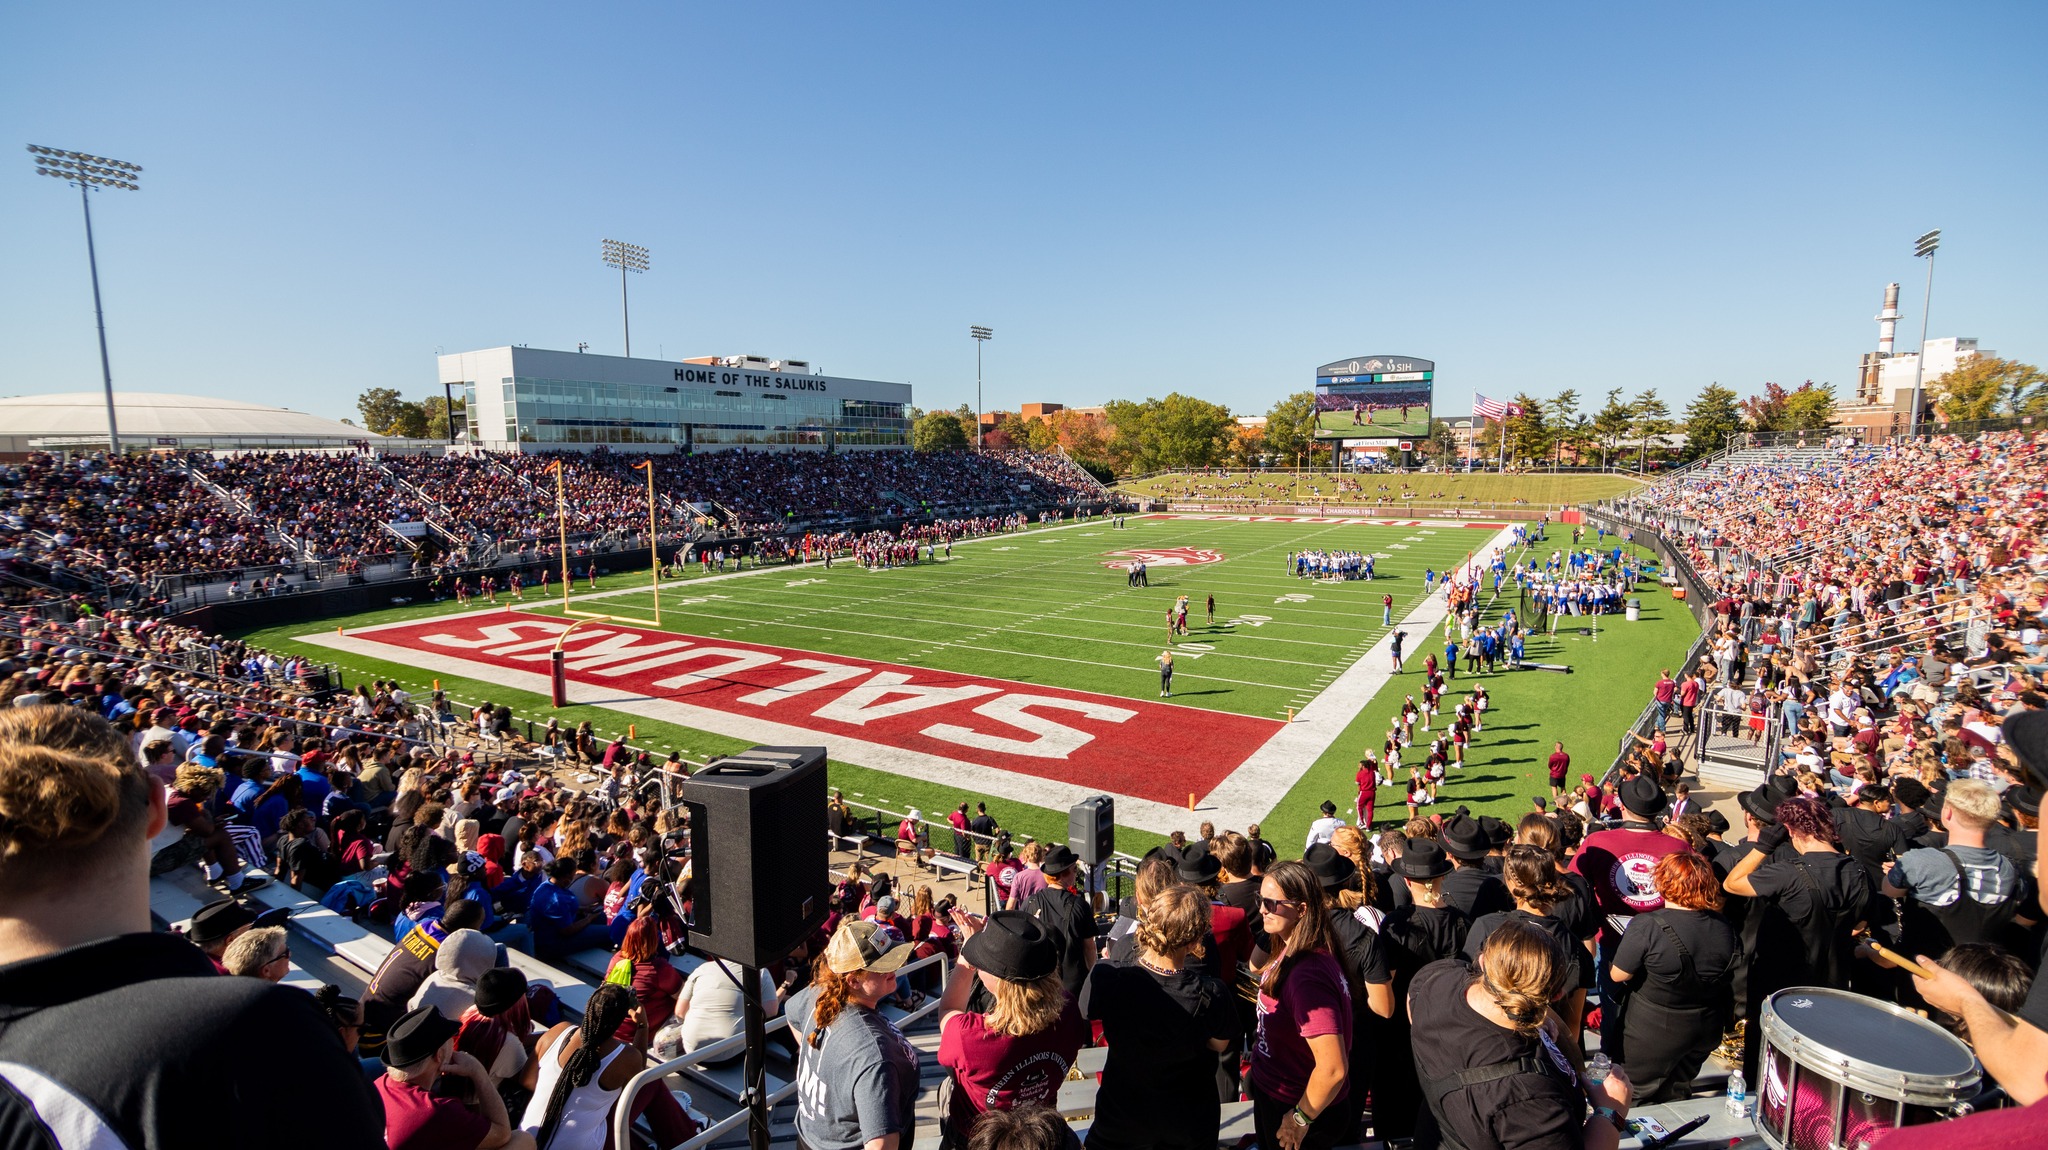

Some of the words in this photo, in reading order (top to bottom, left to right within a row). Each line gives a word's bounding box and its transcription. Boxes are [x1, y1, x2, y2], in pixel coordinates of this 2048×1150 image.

[1397, 363, 1412, 371] SIH
[674, 368, 716, 384] HOME
[722, 372, 739, 385] OF
[744, 374, 770, 388] THE
[775, 377, 827, 392] SALUKIS
[419, 620, 1139, 760] SALUKIS
[369, 948, 404, 995] 1
[1015, 1051, 1050, 1072] ILLINOIS
